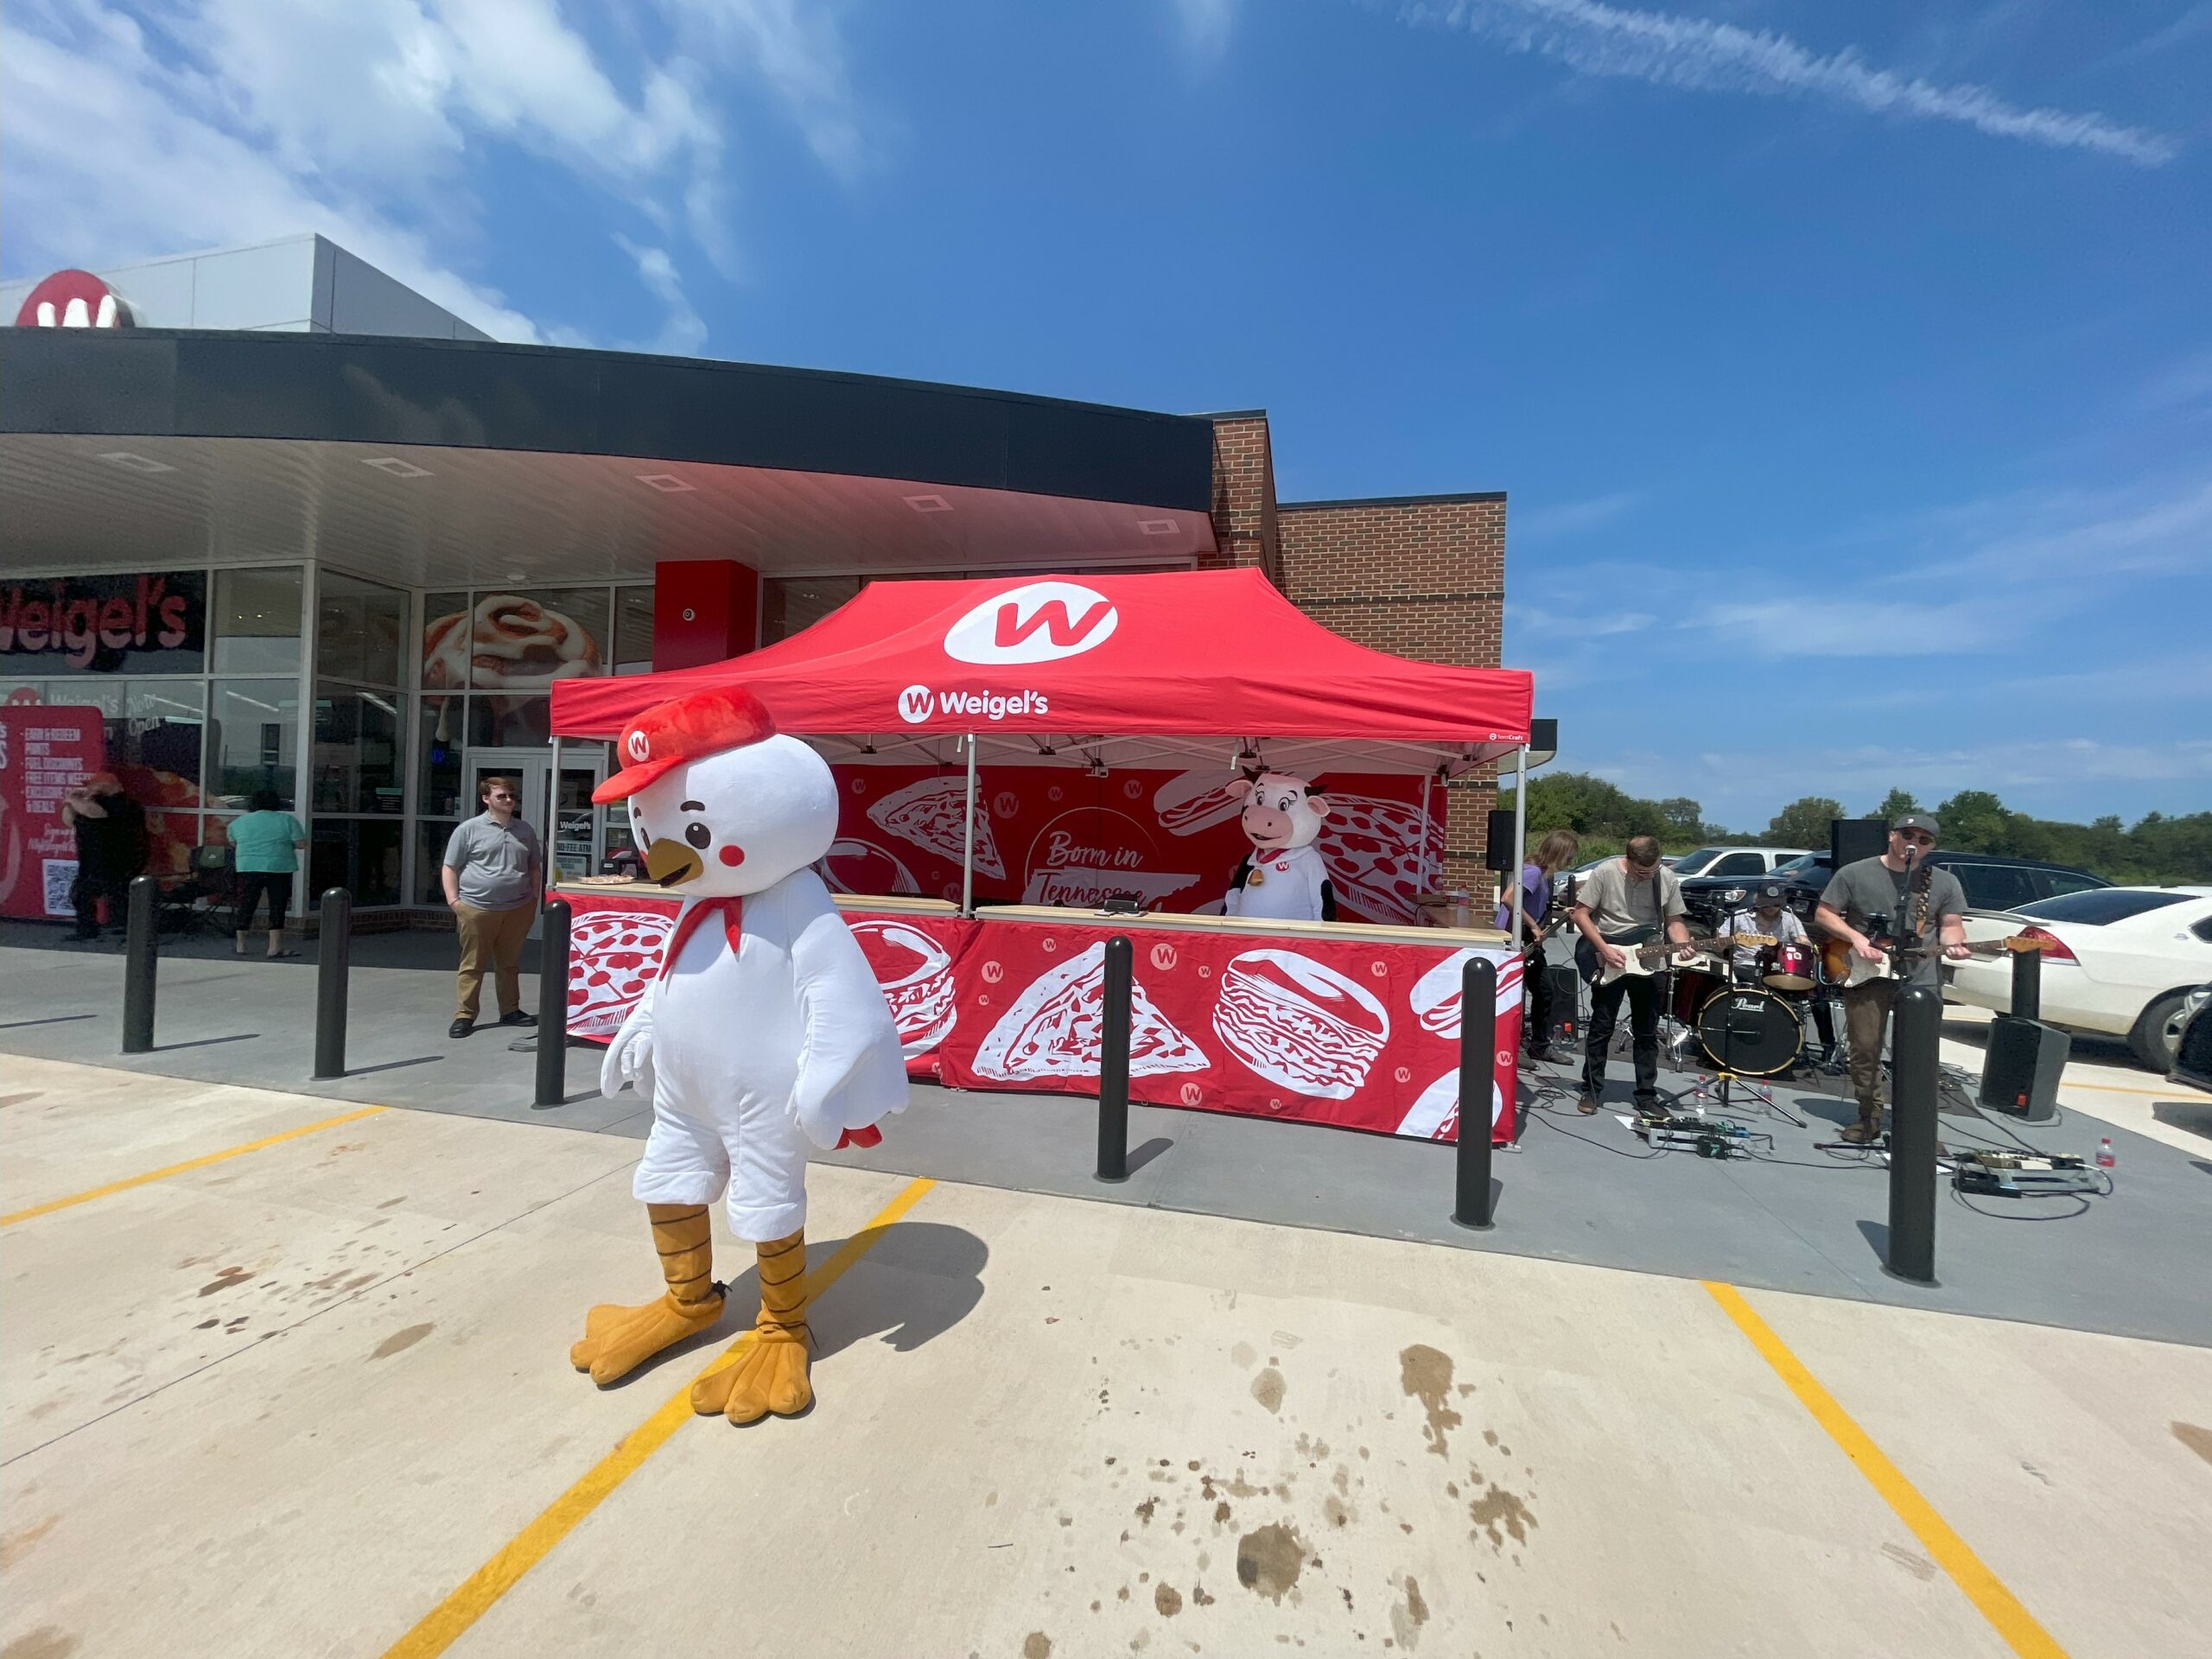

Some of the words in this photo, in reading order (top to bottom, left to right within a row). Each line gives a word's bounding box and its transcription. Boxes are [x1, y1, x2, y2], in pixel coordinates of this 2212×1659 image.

[995, 600, 1114, 647] W
[907, 692, 931, 715] W
[940, 690, 1048, 721] Weigel's
[631, 735, 647, 755] W
[560, 821, 592, 831] Weigel's
[578, 843, 592, 854] ATM
[1047, 830, 1112, 867] Born
[1115, 846, 1144, 868] in
[1037, 872, 1147, 904] Tennese
[1731, 996, 1765, 1011] Pearl
